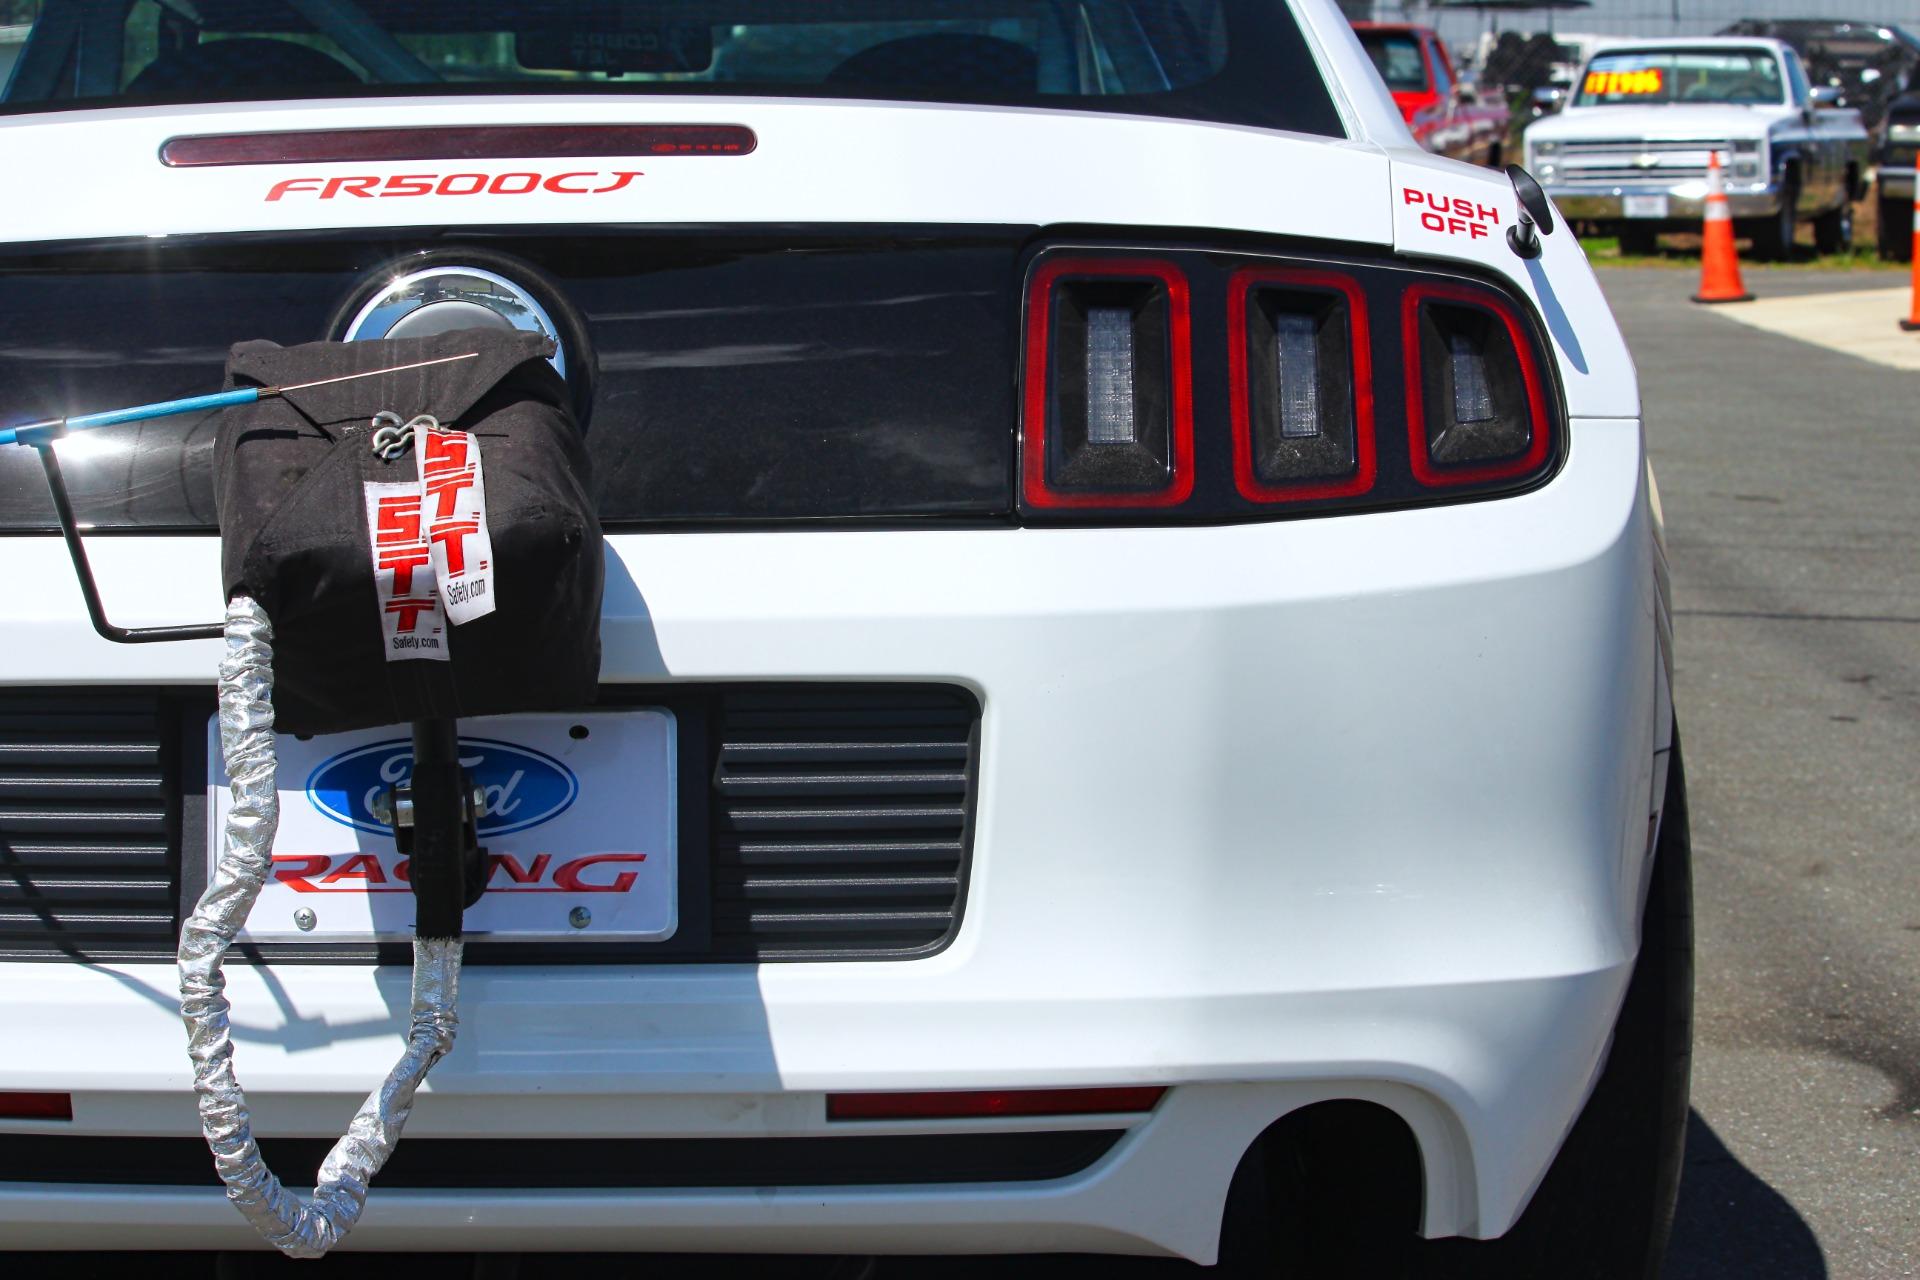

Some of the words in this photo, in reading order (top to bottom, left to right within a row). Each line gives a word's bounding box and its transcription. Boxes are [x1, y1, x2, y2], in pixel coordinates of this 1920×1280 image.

[264, 172, 644, 201] FR500CJ
[1403, 188, 1499, 224] PUSH
[1421, 212, 1488, 239] OFF
[447, 577, 486, 605] Safety.com
[392, 636, 439, 650] Safety.com
[364, 752, 525, 816] Fd
[270, 853, 647, 893] RANG
